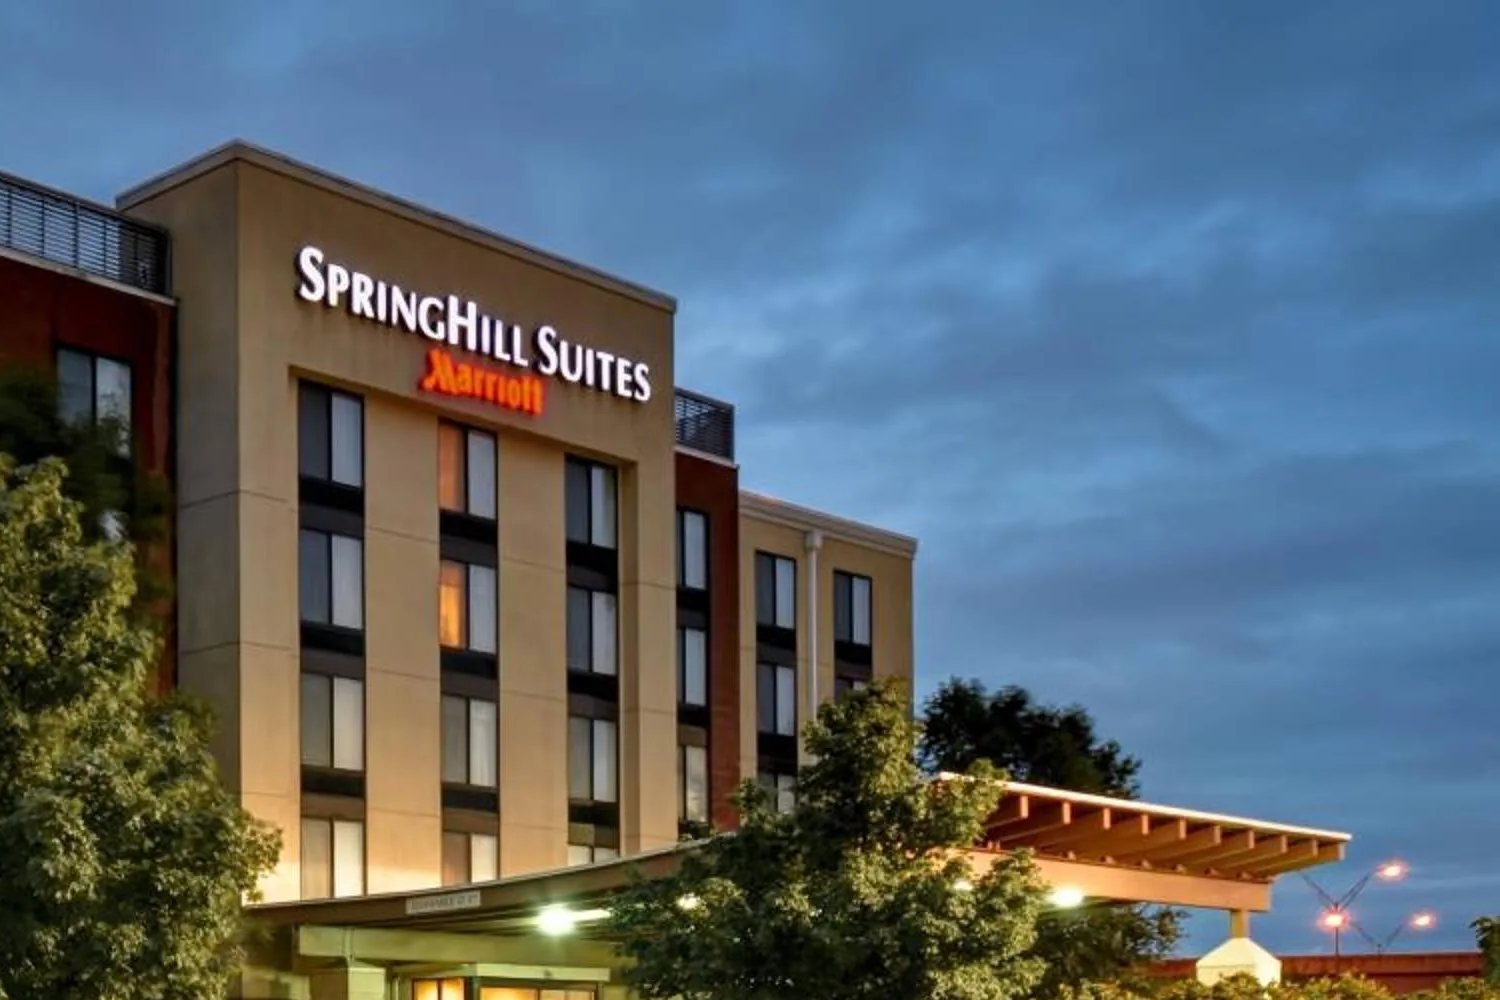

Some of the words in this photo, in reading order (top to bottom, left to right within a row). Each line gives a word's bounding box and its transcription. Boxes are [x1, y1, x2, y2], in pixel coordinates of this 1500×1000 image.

[299, 246, 529, 367] SPRINGHILL
[537, 325, 652, 402] SUITES
[422, 348, 543, 415] Marriott
